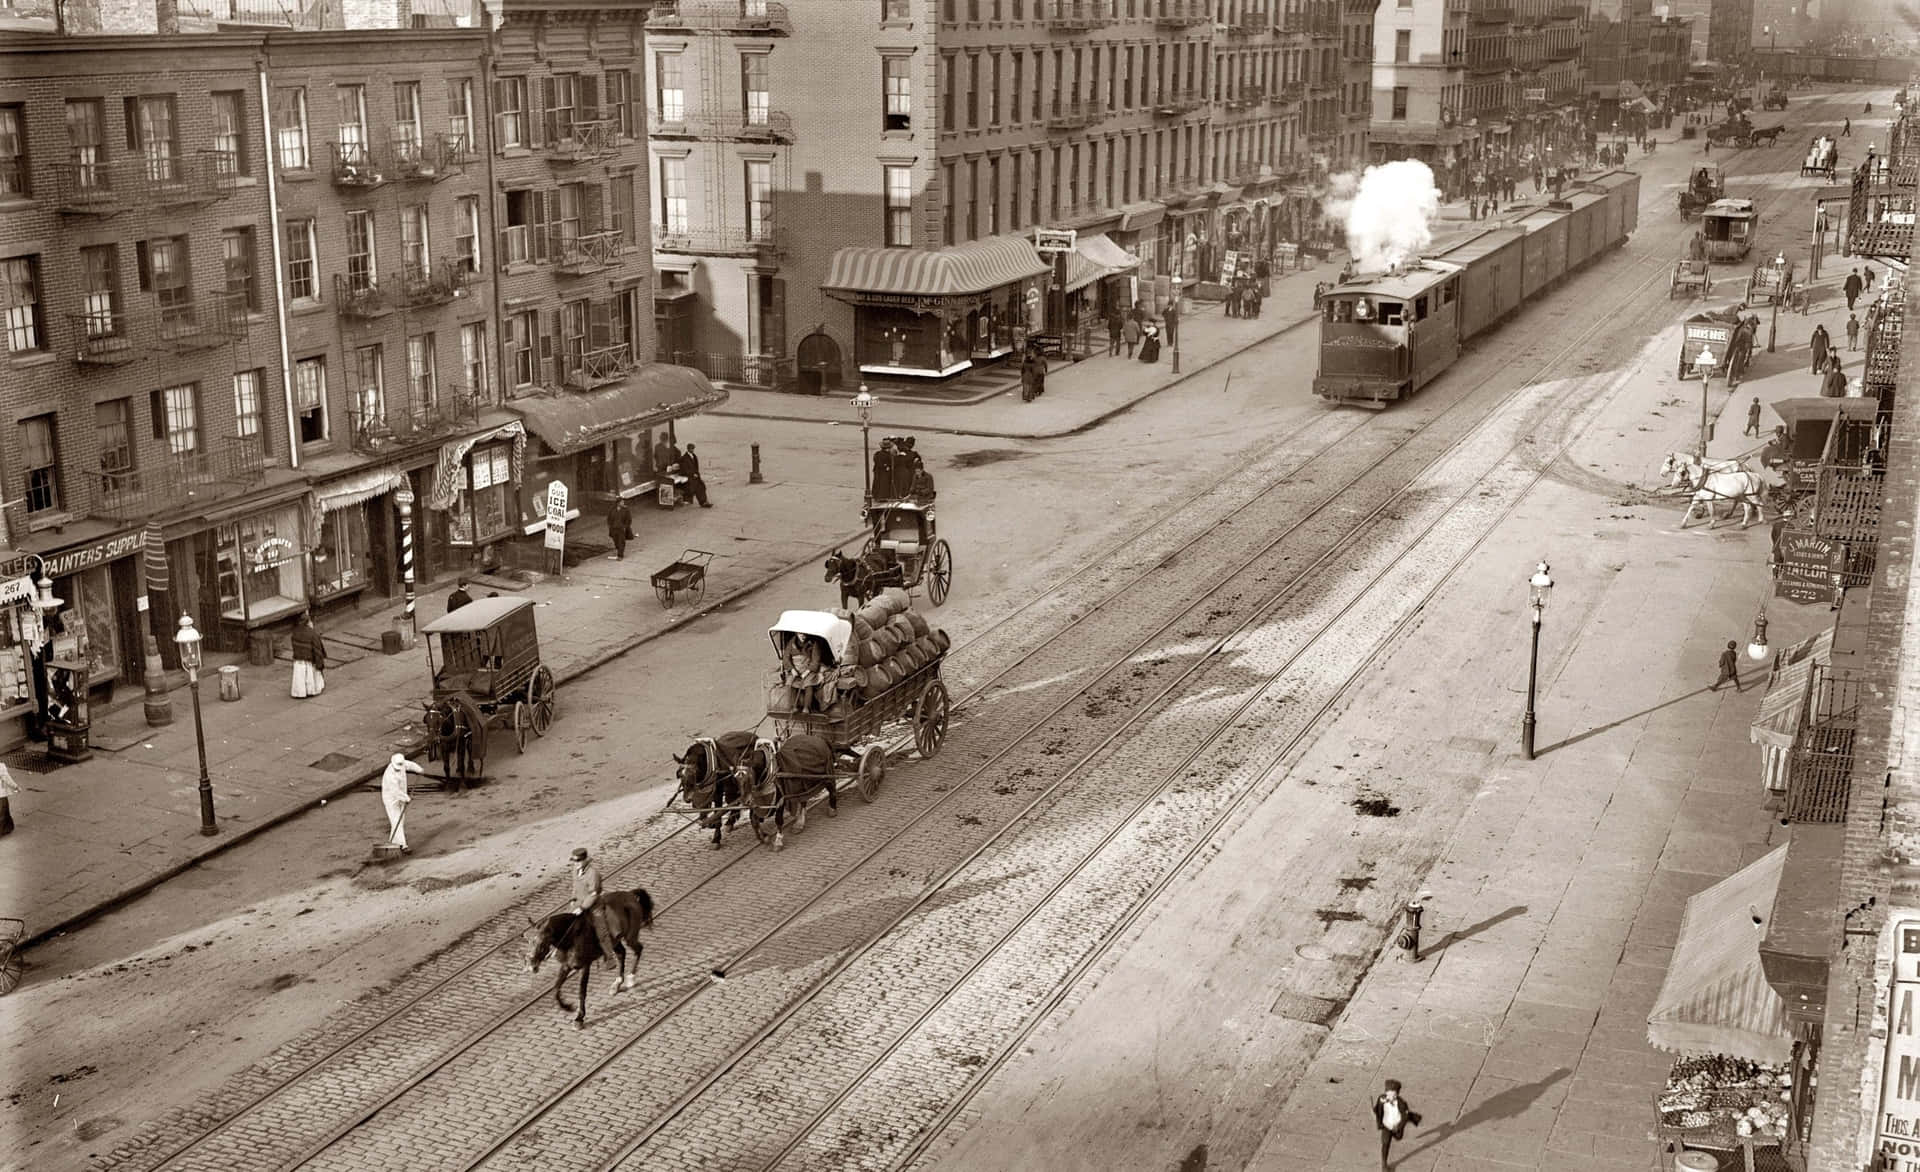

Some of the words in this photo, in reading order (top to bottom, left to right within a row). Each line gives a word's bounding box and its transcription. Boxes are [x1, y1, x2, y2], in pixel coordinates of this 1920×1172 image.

[549, 496, 566, 508] ICE
[547, 505, 565, 519] COAL
[547, 522, 564, 535] WOOD
[1795, 538, 1832, 554] MARTIN
[43, 545, 104, 577] PAINTERS
[105, 530, 147, 558] SUPPLIE
[1786, 561, 1828, 579] TAILOR
[1790, 589, 1817, 600] 272
